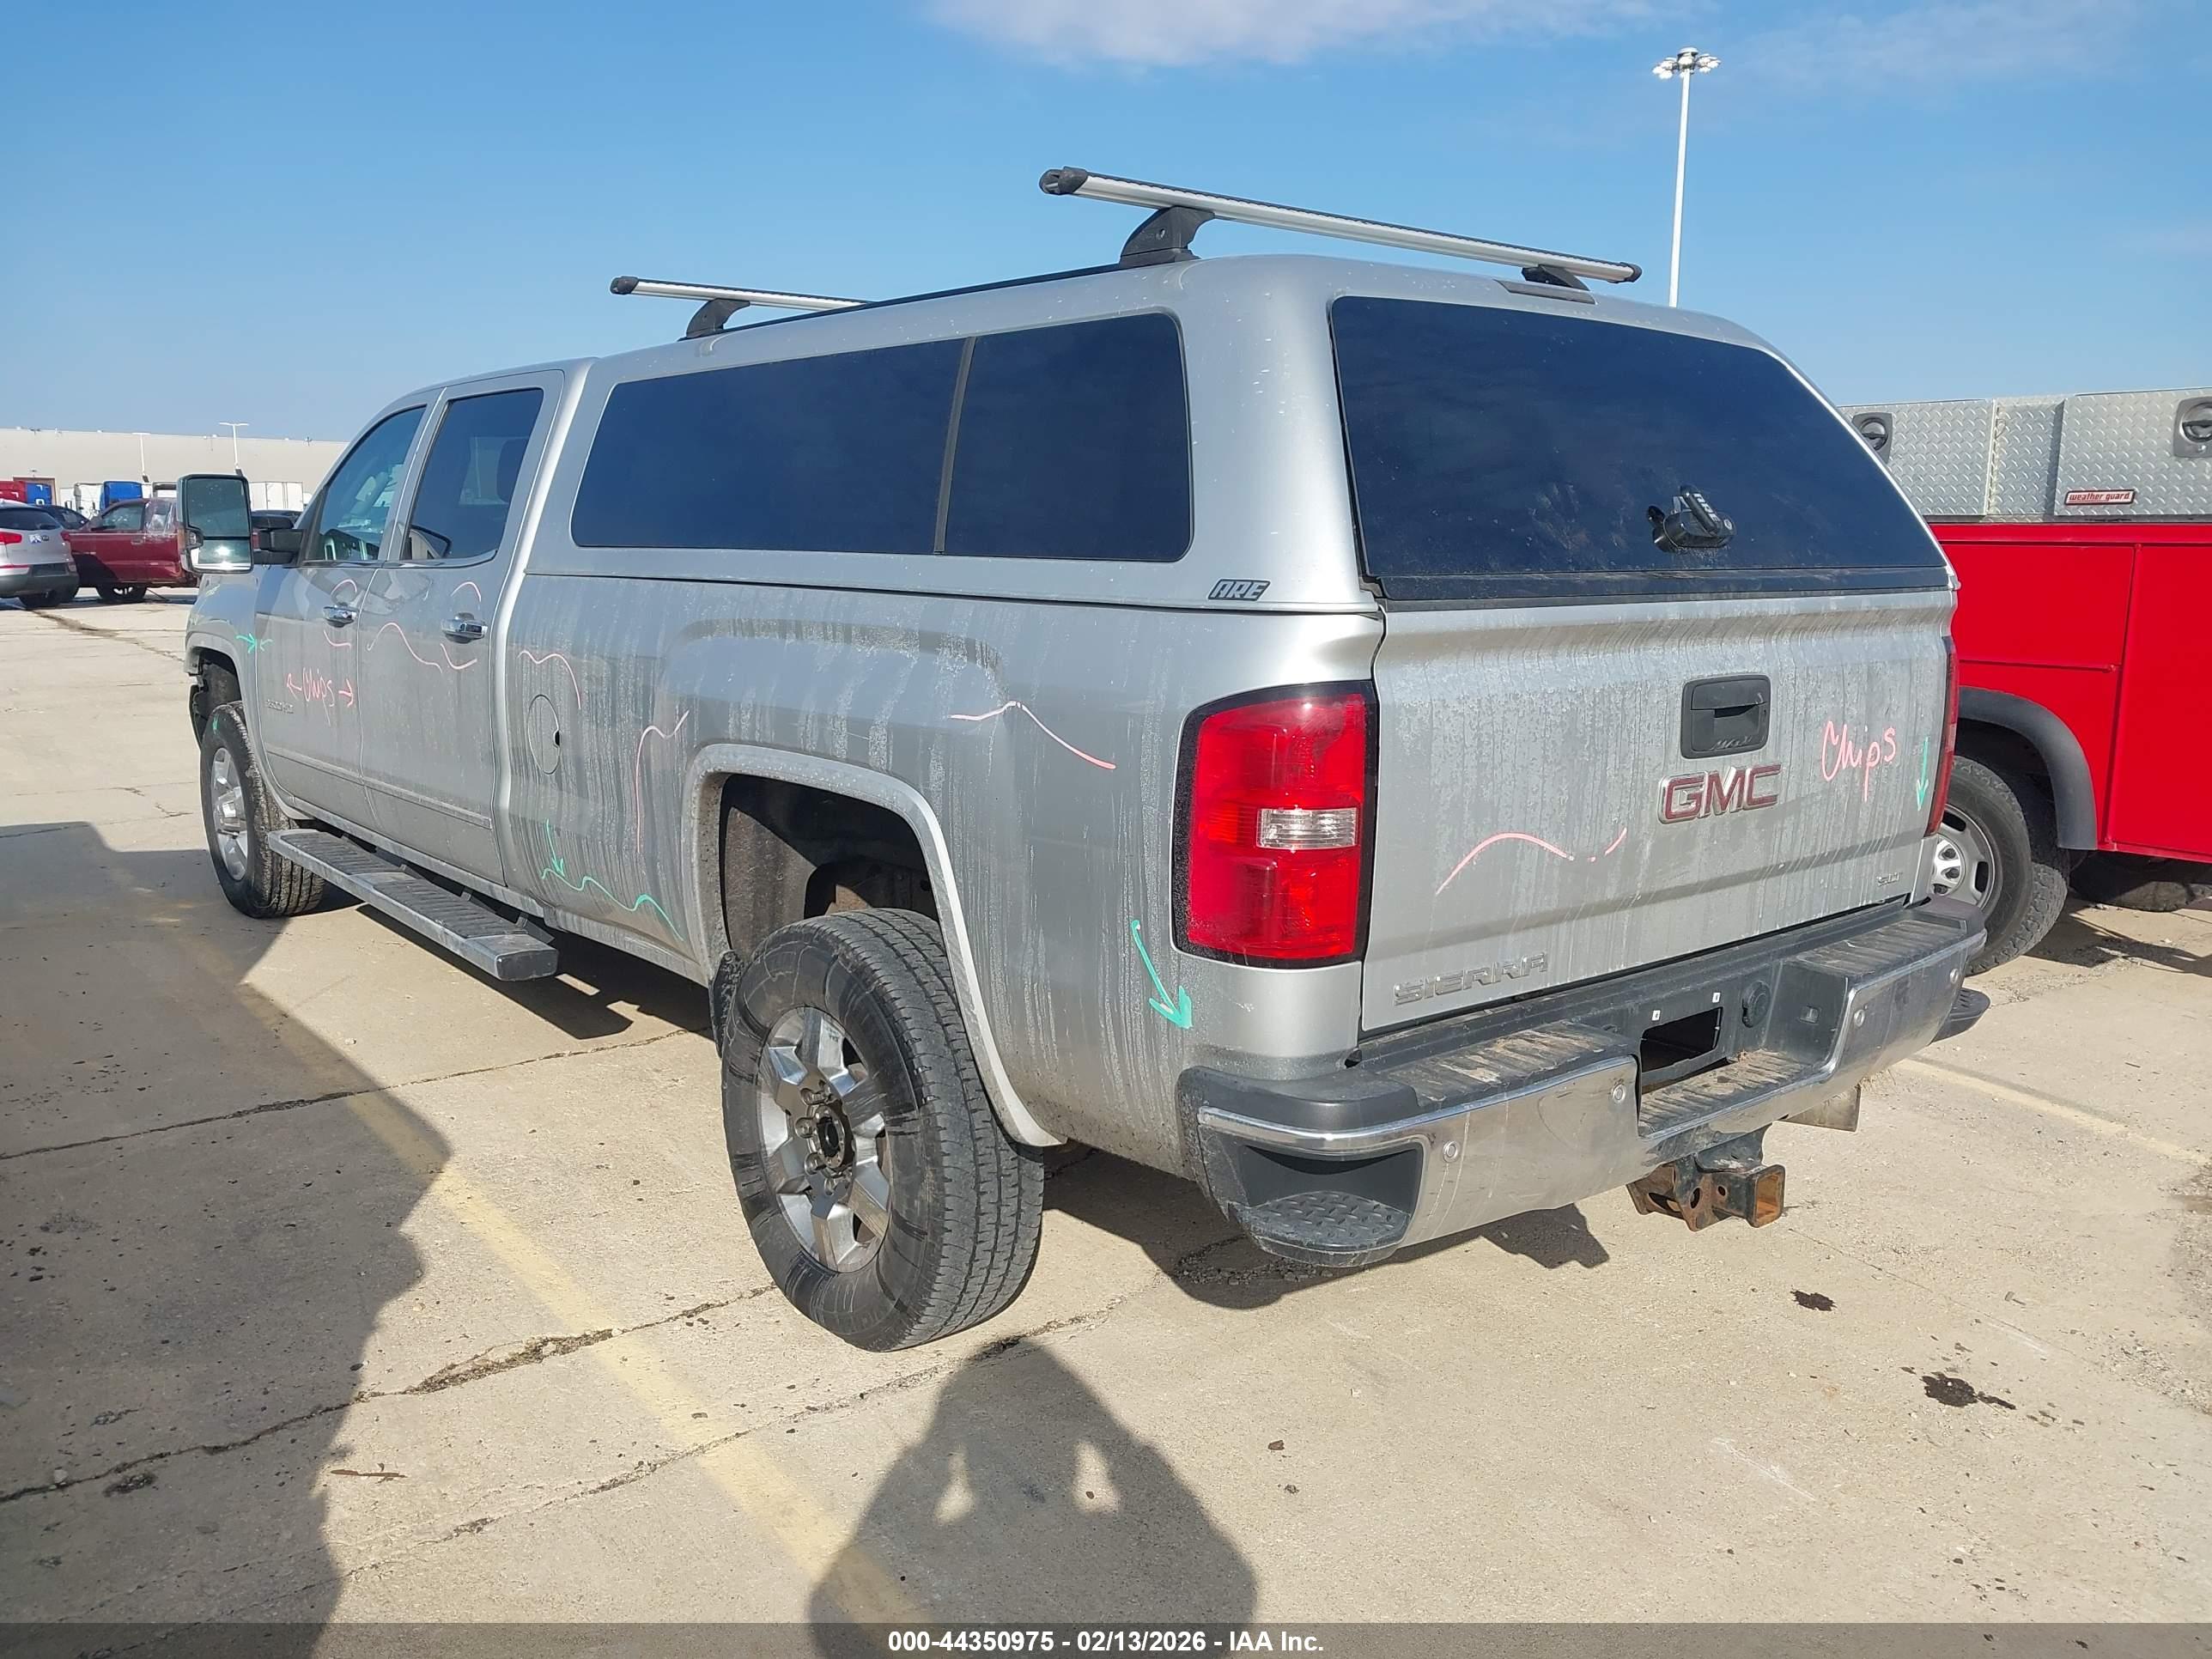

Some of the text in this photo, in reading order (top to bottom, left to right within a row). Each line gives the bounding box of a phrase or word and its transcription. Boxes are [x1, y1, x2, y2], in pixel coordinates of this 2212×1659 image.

[2069, 492, 2130, 502] weather guard
[1821, 720, 1896, 802] Chips
[1658, 763, 1783, 824] GMC
[1394, 951, 1547, 1006] SIERRA
